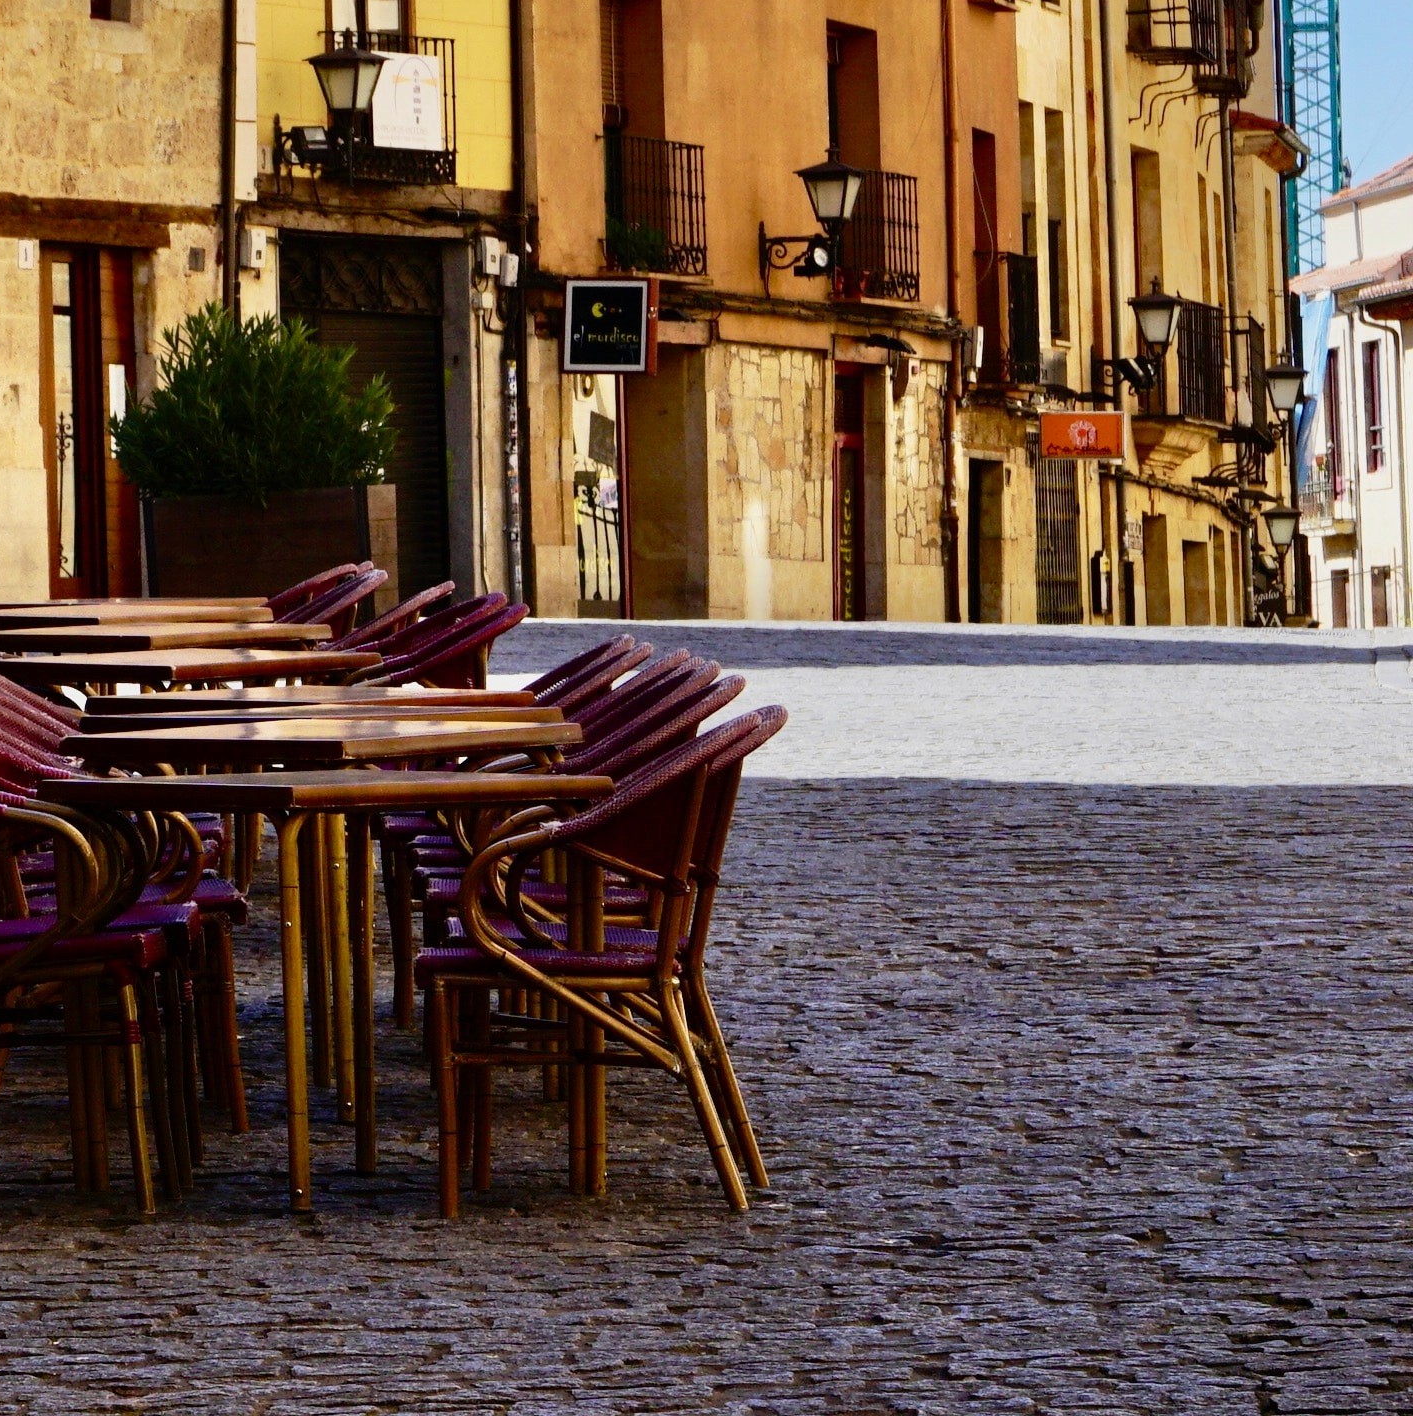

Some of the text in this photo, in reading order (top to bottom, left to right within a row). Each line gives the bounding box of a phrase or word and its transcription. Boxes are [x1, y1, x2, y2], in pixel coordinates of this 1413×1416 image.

[573, 324, 639, 348] el mordisco
[840, 488, 853, 620] mordisco
[1252, 587, 1280, 605] egalos
